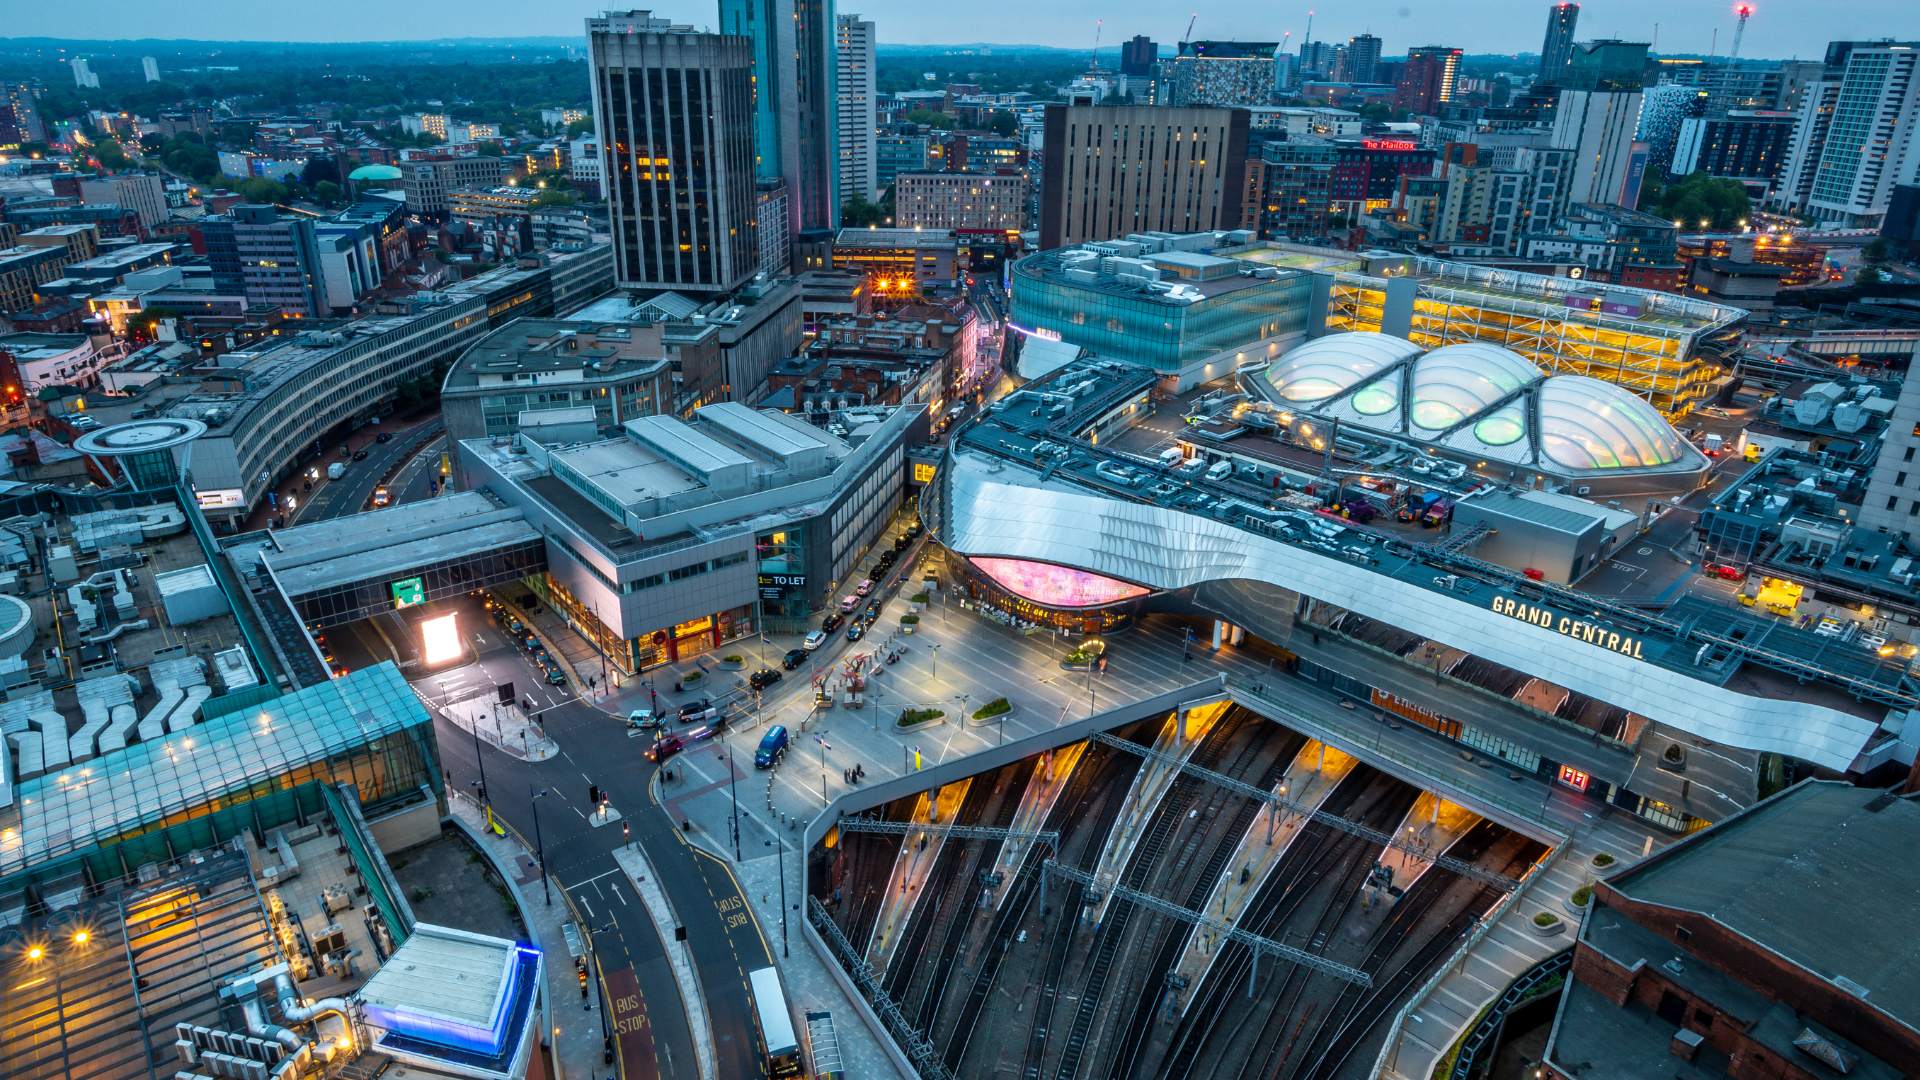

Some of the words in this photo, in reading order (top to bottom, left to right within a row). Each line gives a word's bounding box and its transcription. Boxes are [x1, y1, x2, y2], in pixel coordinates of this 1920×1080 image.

[1363, 140, 1378, 149] The
[1381, 141, 1415, 150] Mailbox
[1612, 563, 1635, 573] STOP
[773, 576, 787, 585] TO
[789, 576, 806, 585] LET
[1493, 596, 1552, 628] GRAND
[1558, 617, 1643, 659] CENTRAL
[720, 896, 742, 912] STOP
[727, 912, 747, 928] BUS
[616, 994, 638, 1014] BUS
[618, 1014, 645, 1034] STOP
